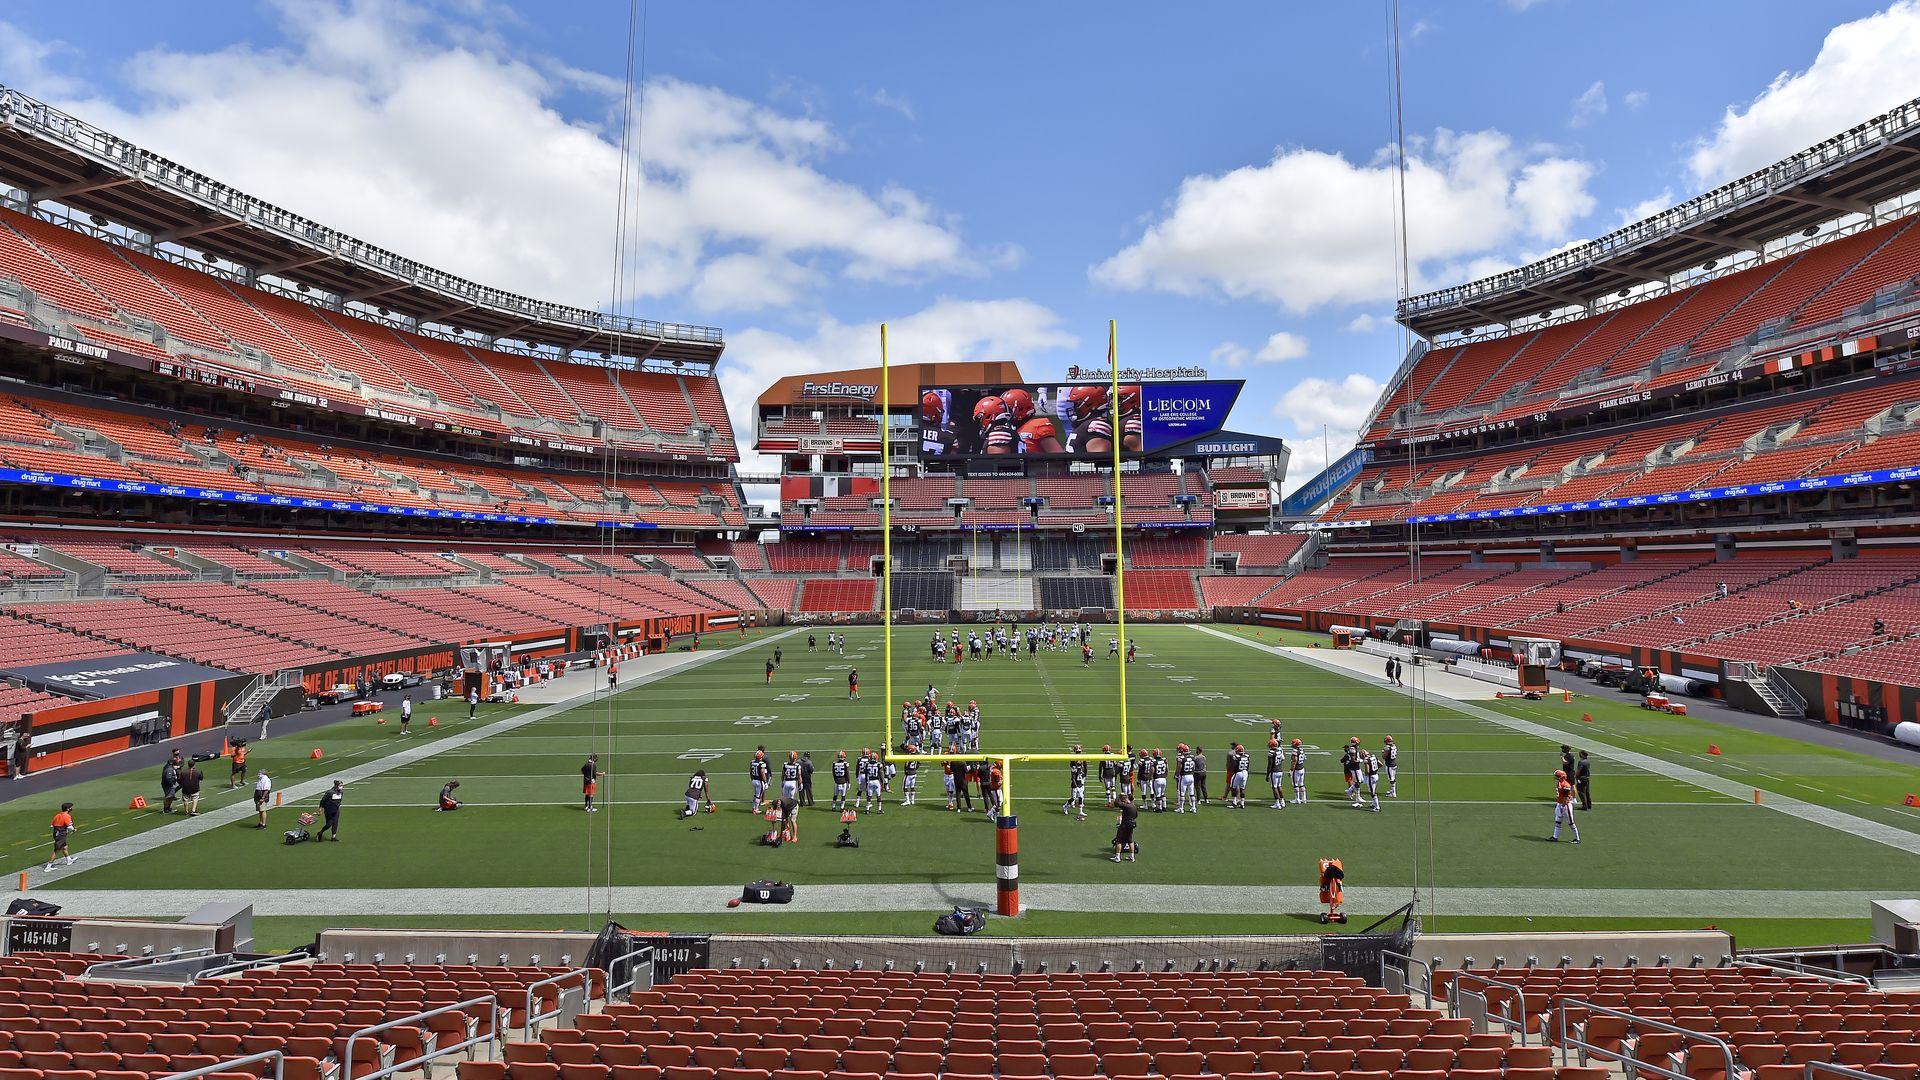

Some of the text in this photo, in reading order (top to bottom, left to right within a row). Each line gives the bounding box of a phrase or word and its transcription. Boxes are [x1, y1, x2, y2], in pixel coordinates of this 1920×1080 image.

[48, 336, 109, 359] PAUL BROWN
[1080, 366, 1205, 381] University Hospitals
[1685, 370, 1743, 391] LEROY KELLY 44
[803, 382, 878, 397] FirstEnergy
[280, 391, 328, 408] JIM BROWN 32
[1148, 399, 1211, 411] LECOM
[1600, 391, 1652, 409] FRANK GATSKI 52
[365, 408, 416, 425] PAUL WARFIELD 42
[1535, 414, 1547, 422] 9:32
[924, 430, 938, 440] LER
[1197, 444, 1255, 452] BUD LIGHT
[21, 474, 37, 482] drug
[71, 479, 85, 487] drug
[118, 483, 131, 491] drug
[325, 651, 453, 690] OF THE CLEVELAND BROWNS
[785, 769, 796, 778] 43
[691, 778, 703, 789] 70
[137, 798, 144, 807] G
[654, 949, 690, 962] 46•147
